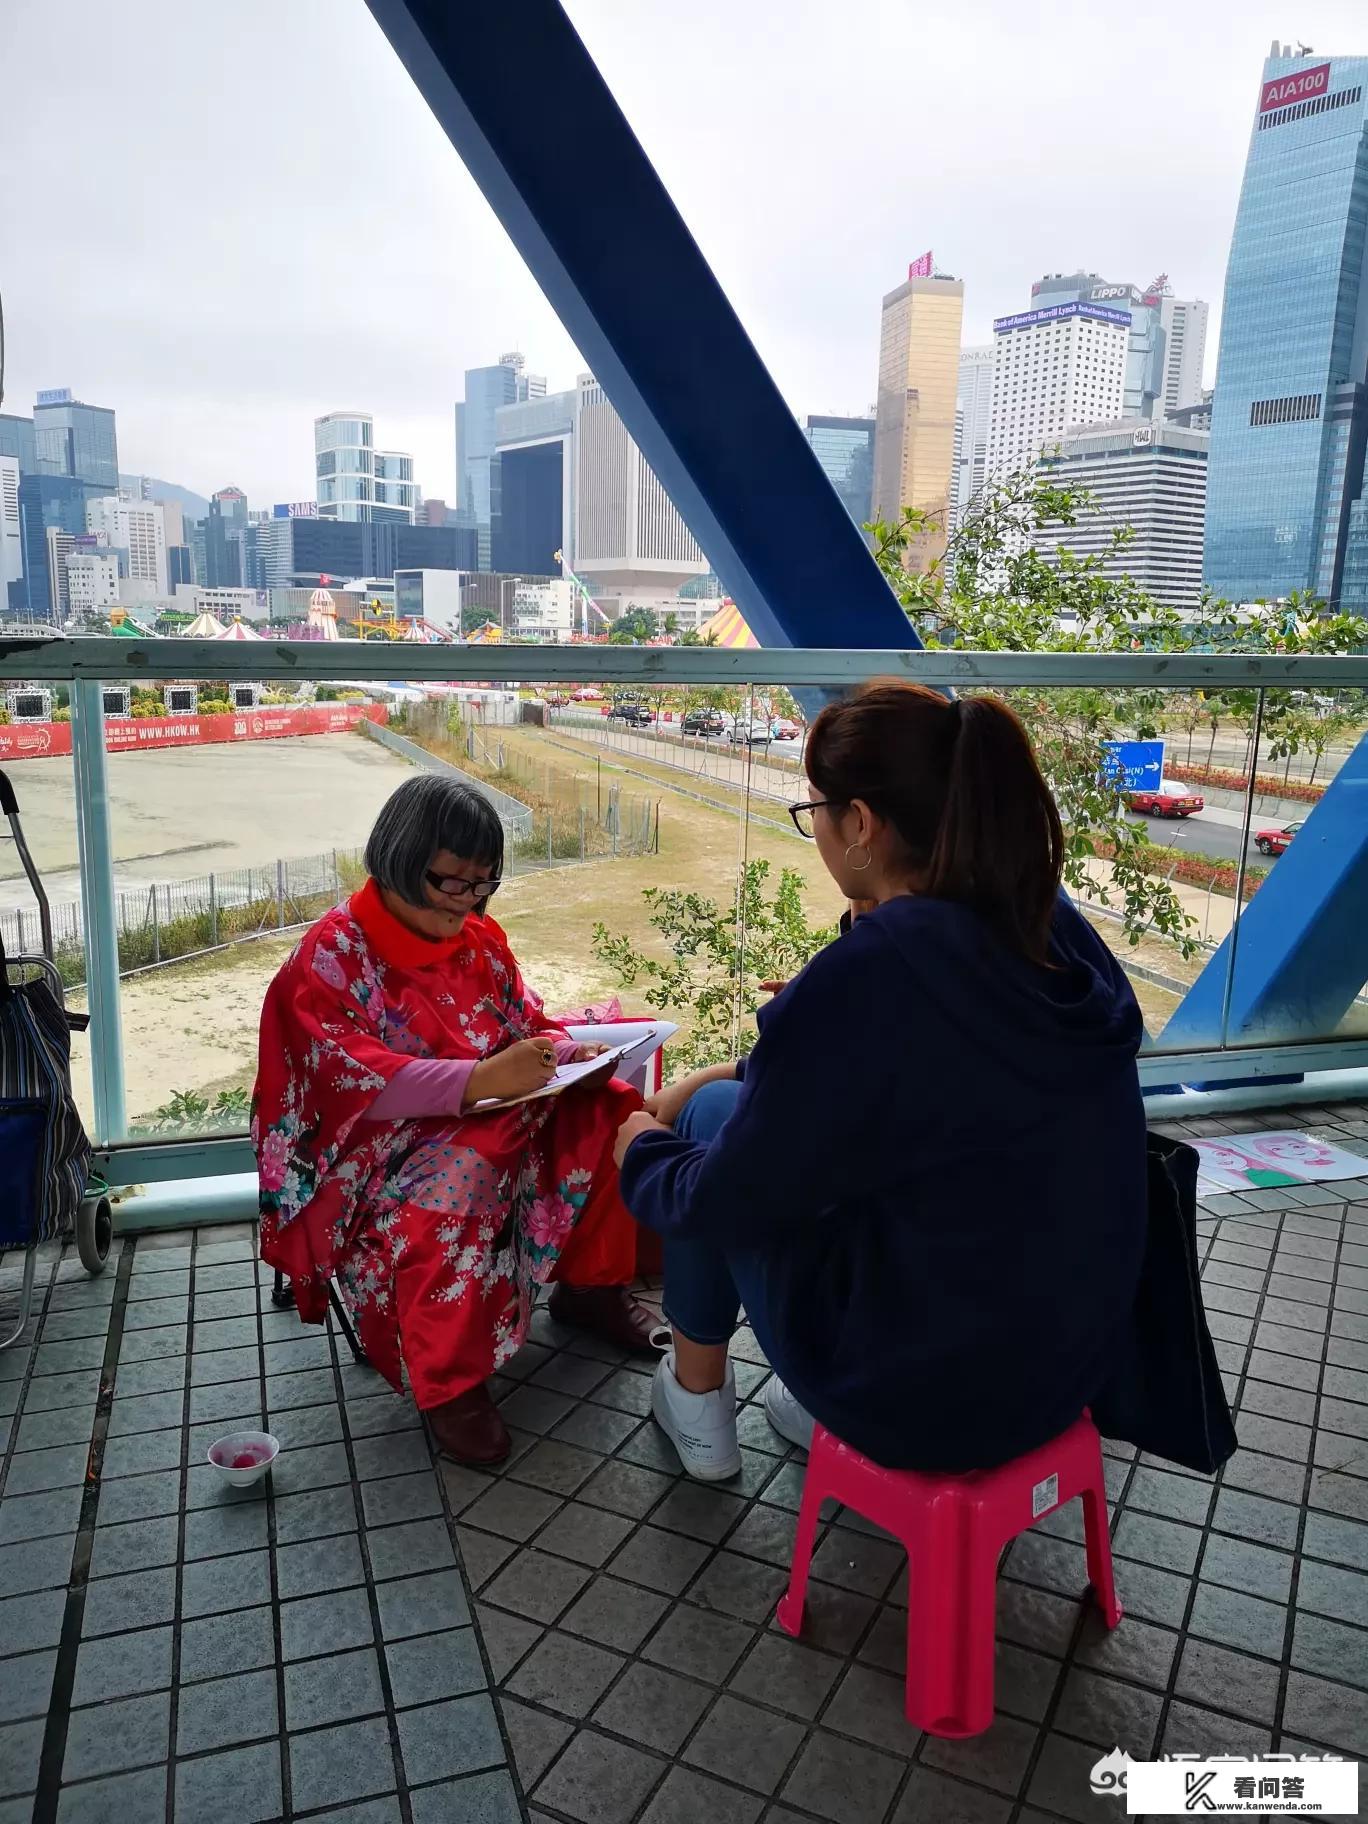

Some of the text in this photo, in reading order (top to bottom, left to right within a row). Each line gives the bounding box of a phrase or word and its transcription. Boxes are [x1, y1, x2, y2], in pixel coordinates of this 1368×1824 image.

[1090, 287, 1126, 299] LIPPO
[994, 320, 1007, 329] Bank
[1014, 314, 1037, 325] America
[1038, 307, 1058, 320] Merrill
[1058, 303, 1077, 316] Lynch
[139, 724, 200, 740] WWW.HKOW.HK
